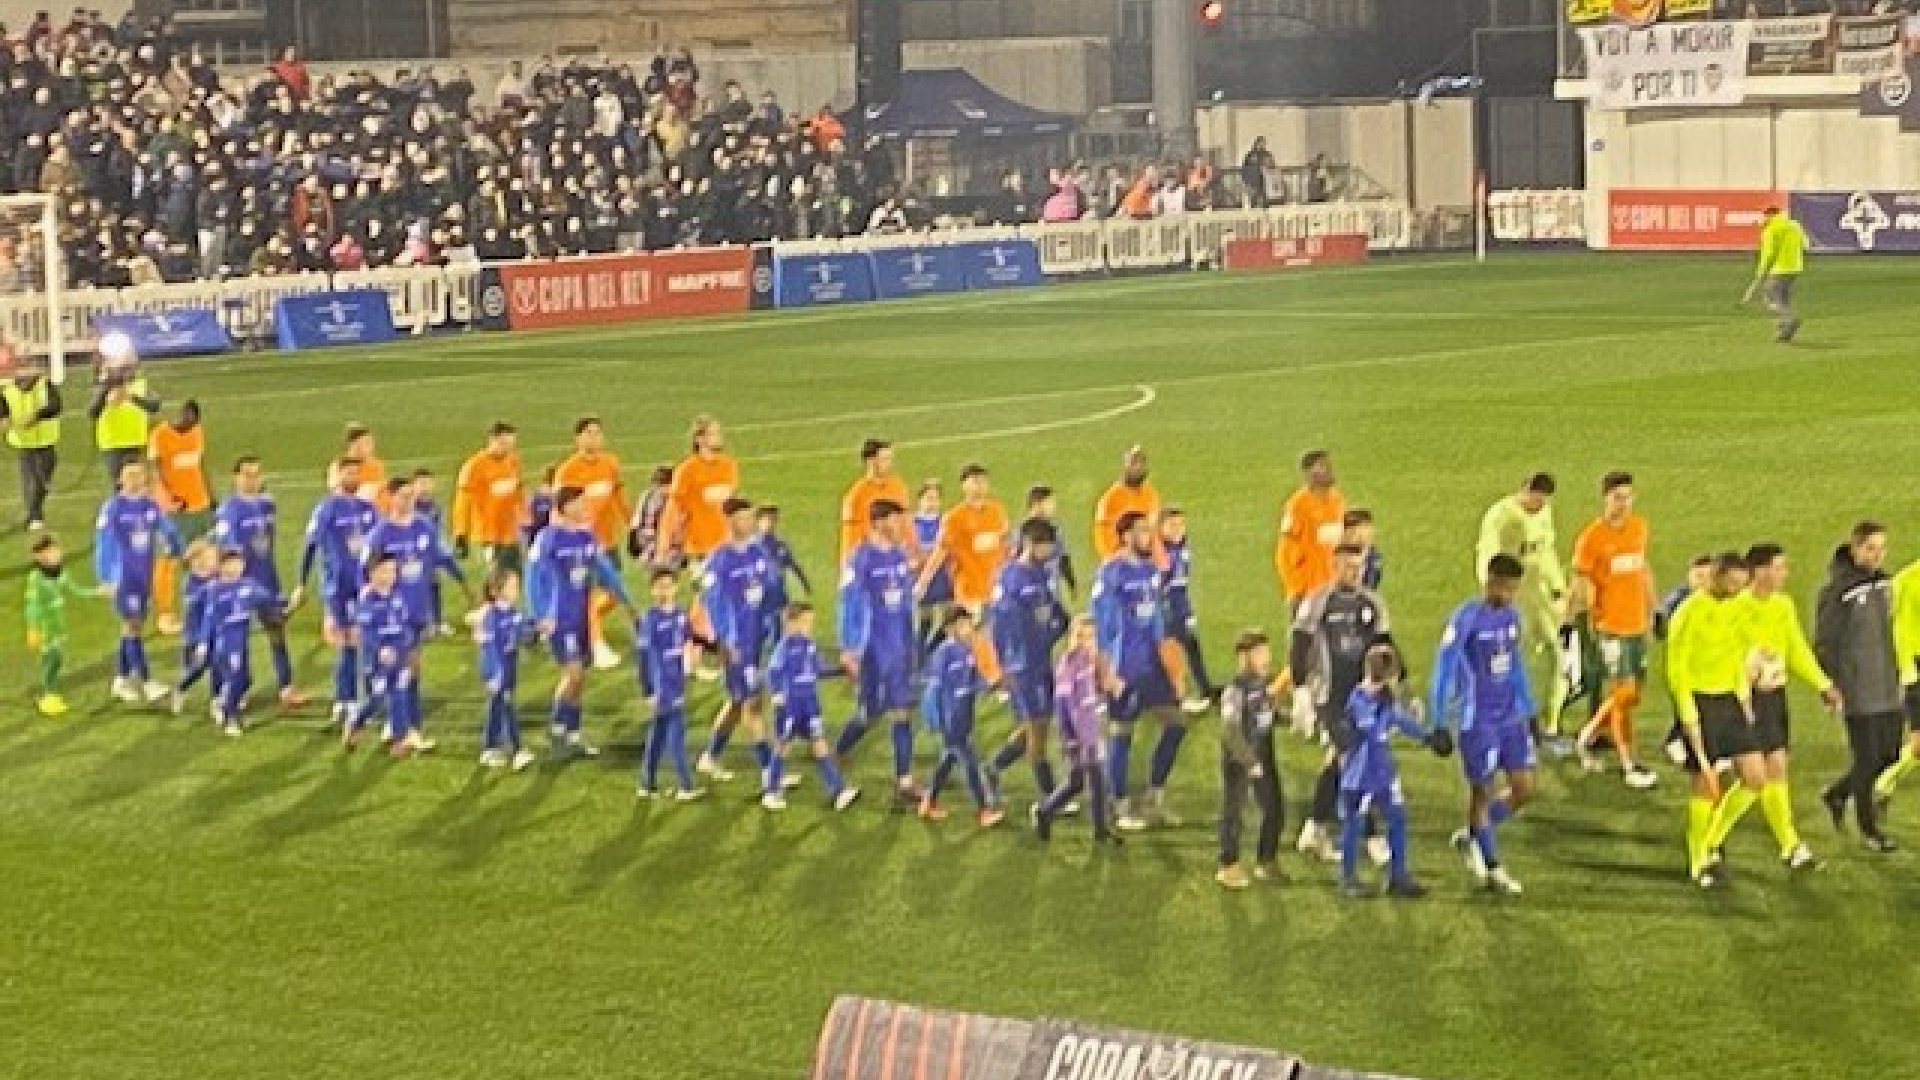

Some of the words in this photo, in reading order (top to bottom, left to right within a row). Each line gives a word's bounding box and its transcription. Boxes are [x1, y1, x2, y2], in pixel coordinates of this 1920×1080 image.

[1594, 27, 1630, 57] VOY
[1645, 29, 1660, 54] A
[1670, 25, 1735, 54] MORIR
[1631, 70, 1674, 101] POR
[1678, 69, 1697, 97] TI
[539, 274, 583, 314] COPA
[586, 272, 618, 309] DEL
[620, 269, 651, 305] REY
[668, 270, 747, 293] MAPFRE
